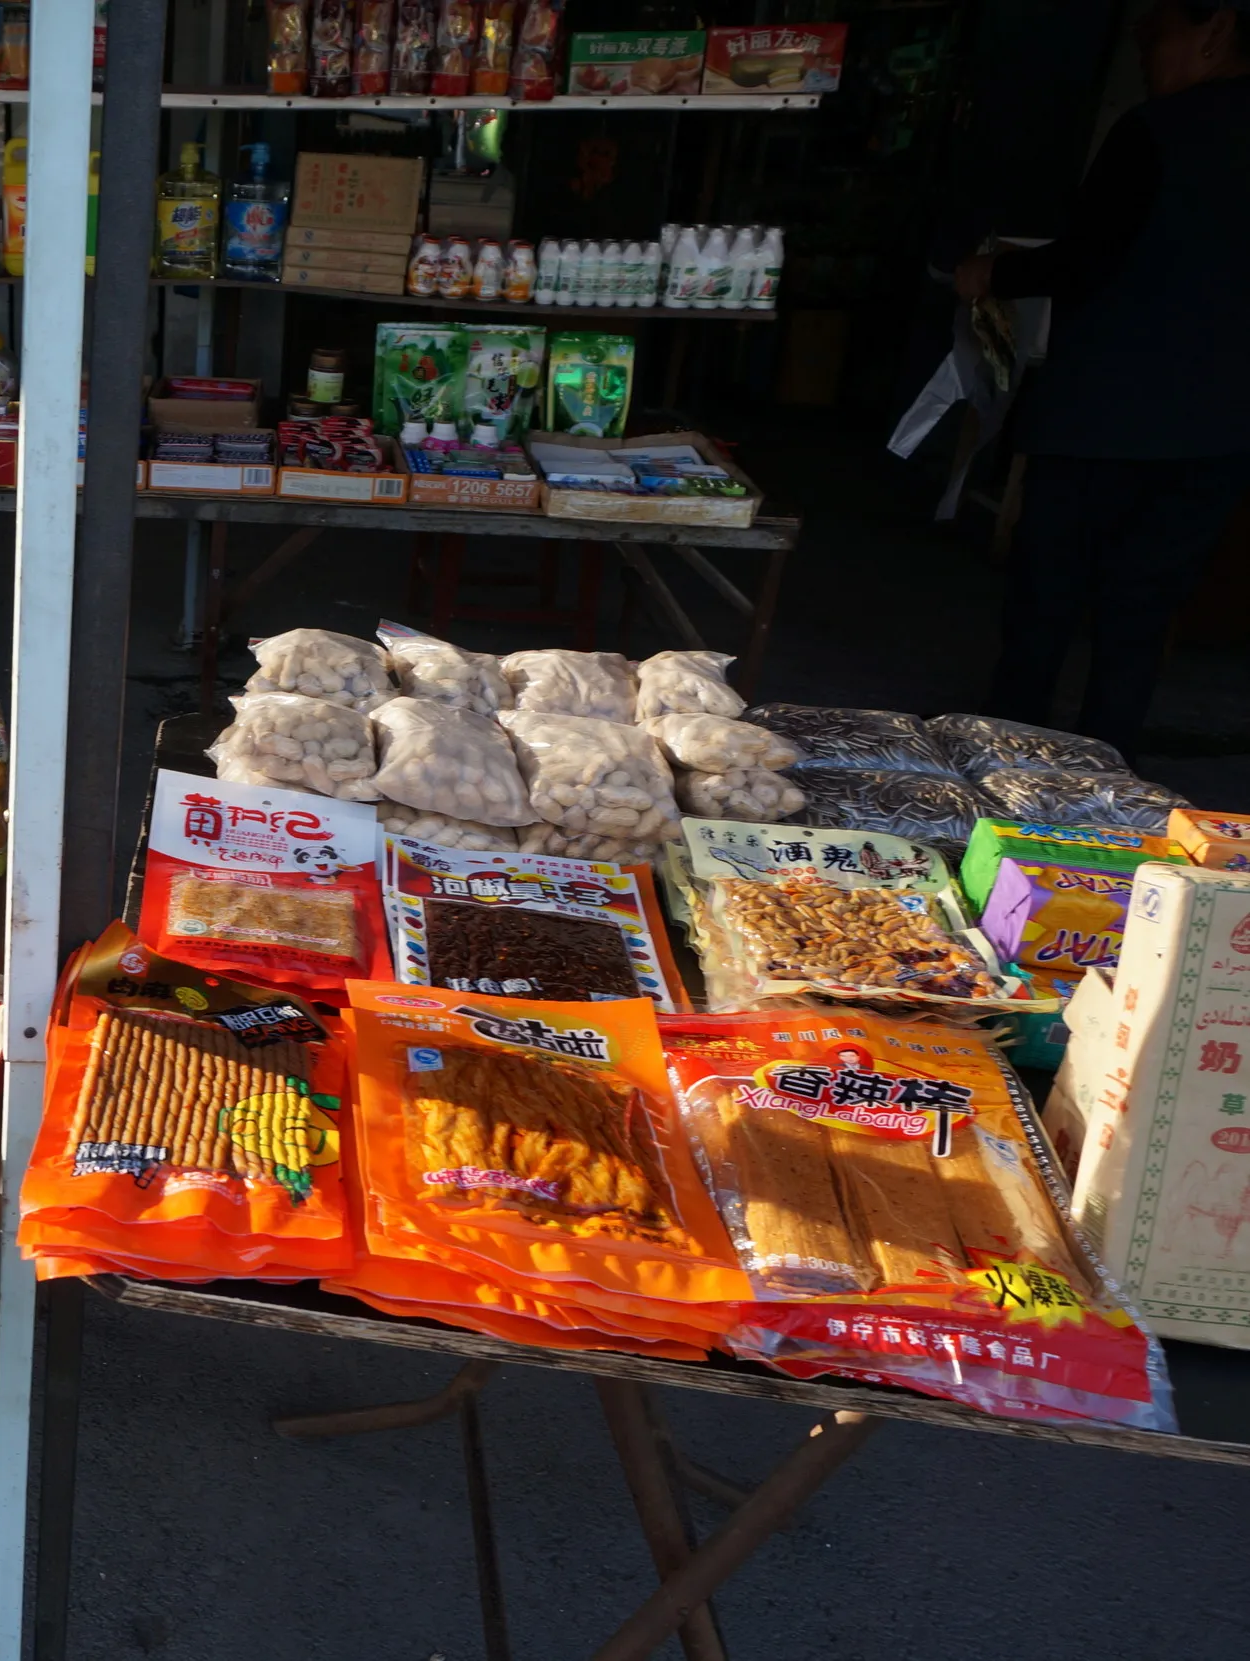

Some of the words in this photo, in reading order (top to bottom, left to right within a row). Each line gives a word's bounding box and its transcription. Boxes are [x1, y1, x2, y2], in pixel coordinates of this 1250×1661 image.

[453, 479, 490, 495] 1206
[496, 482, 535, 498] 5657
[765, 838, 865, 876] 酒鬼
[1197, 1040, 1243, 1074] 奶
[735, 1084, 928, 1135] XiangLabang
[767, 1065, 974, 1156] 香辣棒
[1218, 1093, 1247, 1115] 草
[826, 1316, 1061, 1371] 伊宁市好兴隆食品厂
